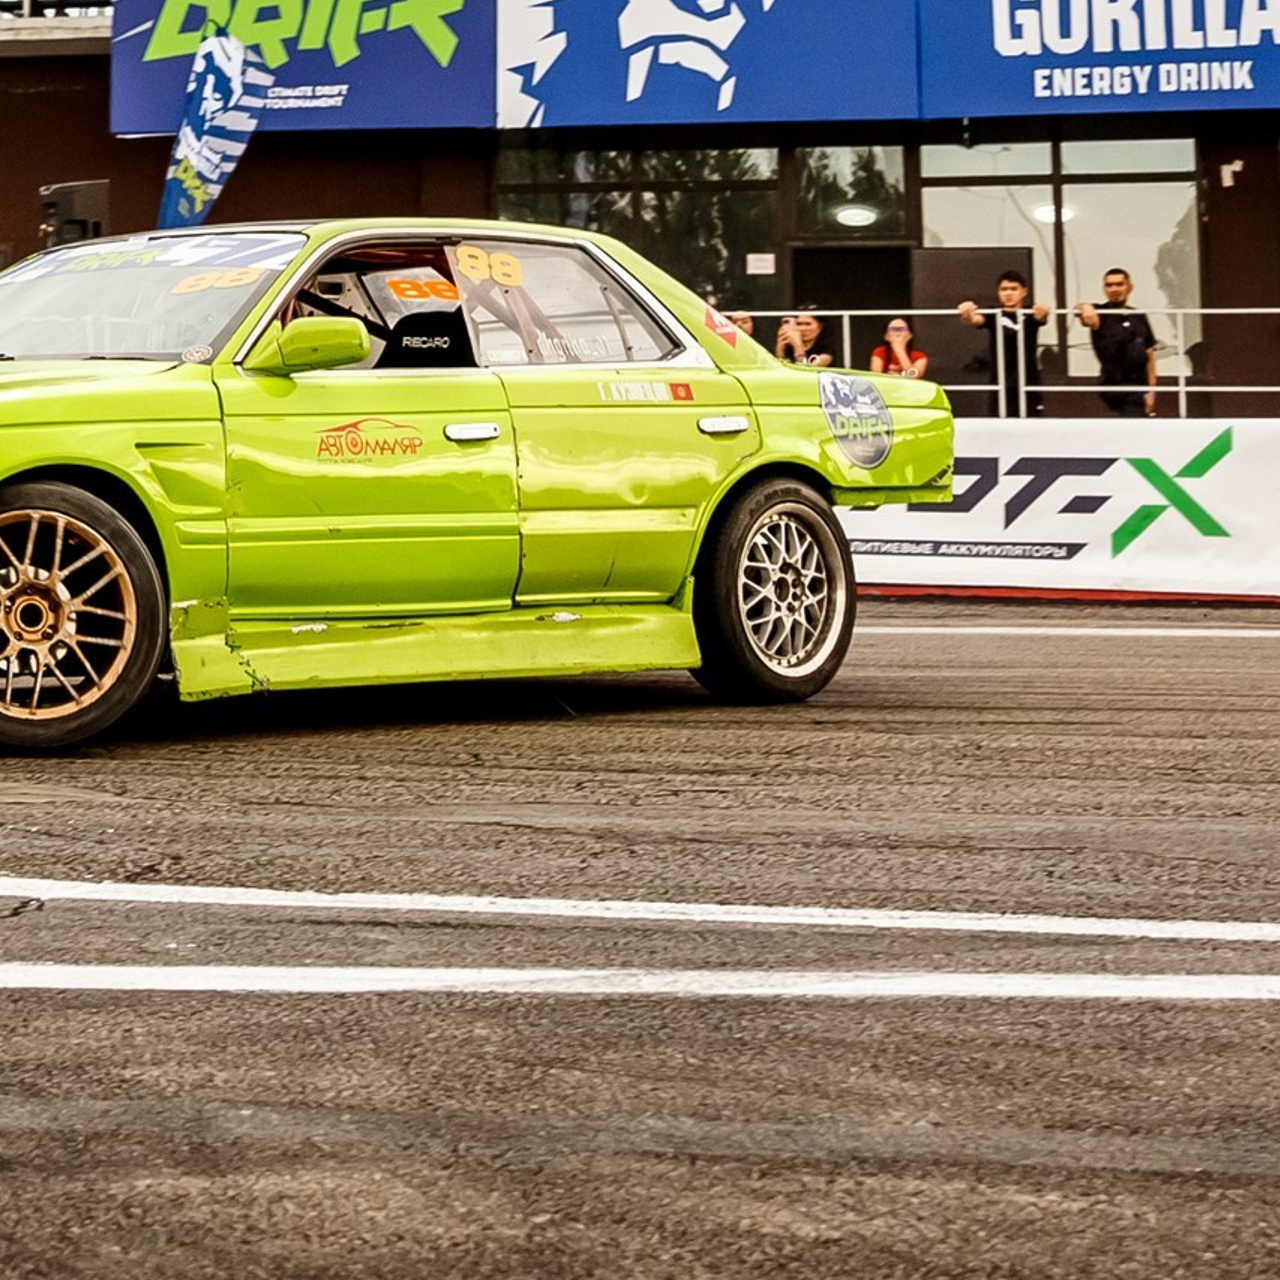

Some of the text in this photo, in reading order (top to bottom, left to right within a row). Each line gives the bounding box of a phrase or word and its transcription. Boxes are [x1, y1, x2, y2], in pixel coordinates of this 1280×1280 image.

[1033, 61, 1254, 98] ENERGY DRINK
[456, 246, 523, 287] 88
[171, 269, 265, 295] 88
[387, 279, 460, 302] 88
[402, 336, 451, 349] RECARO
[937, 543, 1068, 558] АККУМУЛЯТОРЫ
